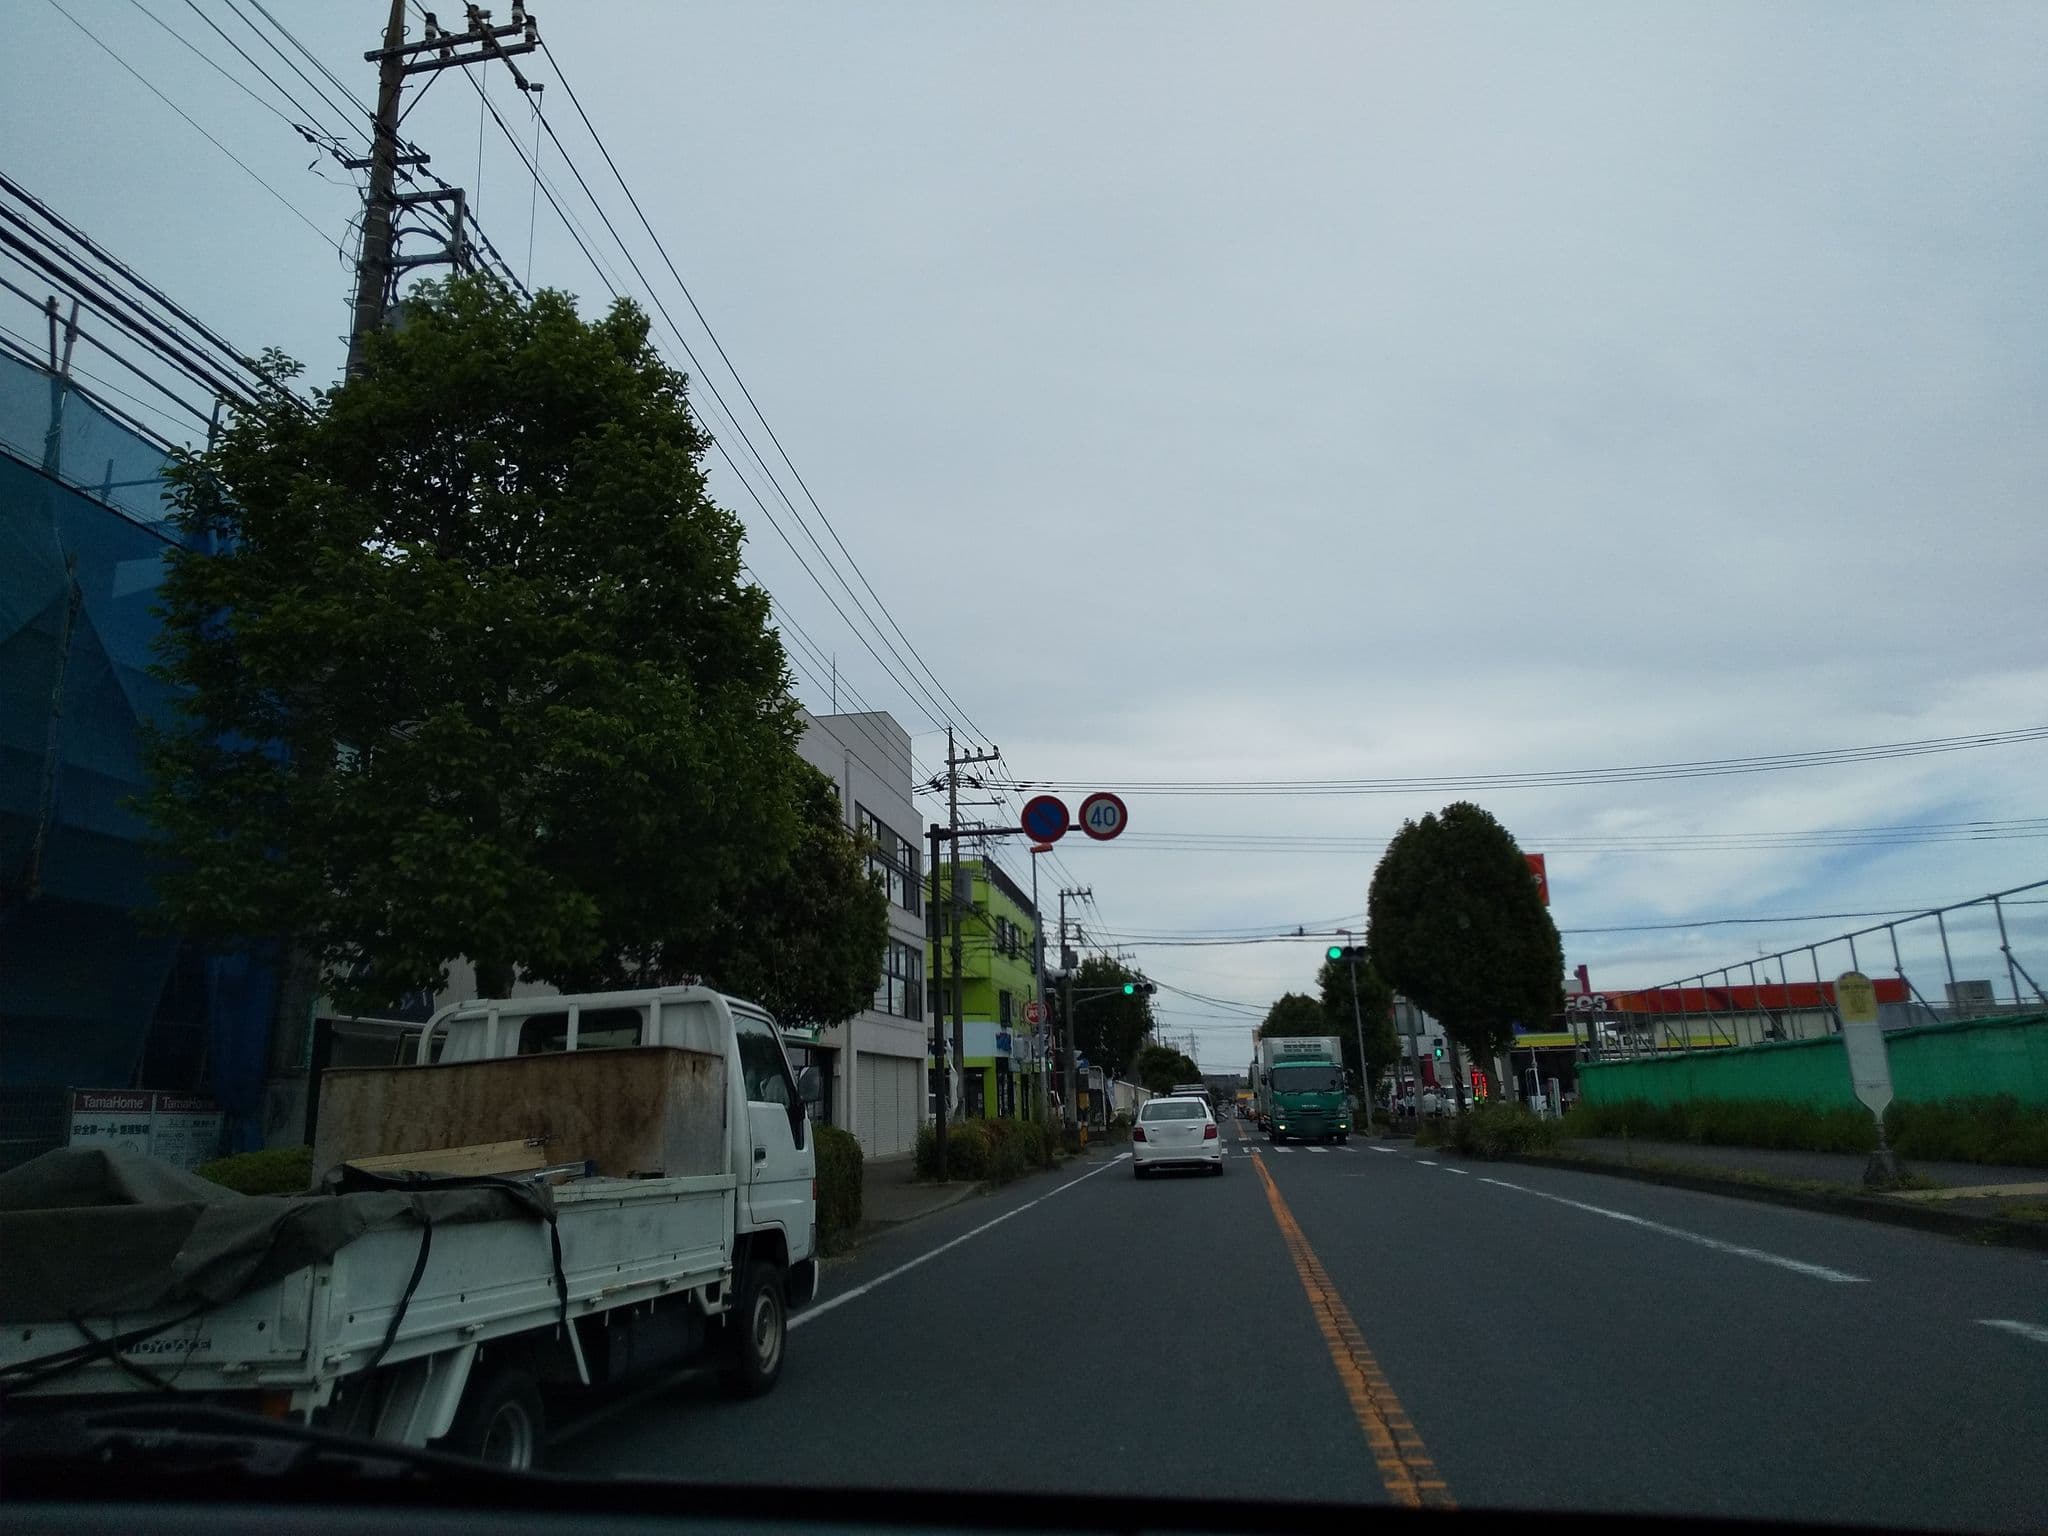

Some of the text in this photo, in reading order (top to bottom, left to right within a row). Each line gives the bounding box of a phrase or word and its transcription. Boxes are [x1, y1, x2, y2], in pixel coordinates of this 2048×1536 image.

[1090, 805, 1116, 827] 40
[82, 1094, 145, 1109] TamaHome
[161, 1096, 207, 1110] TamaHo
